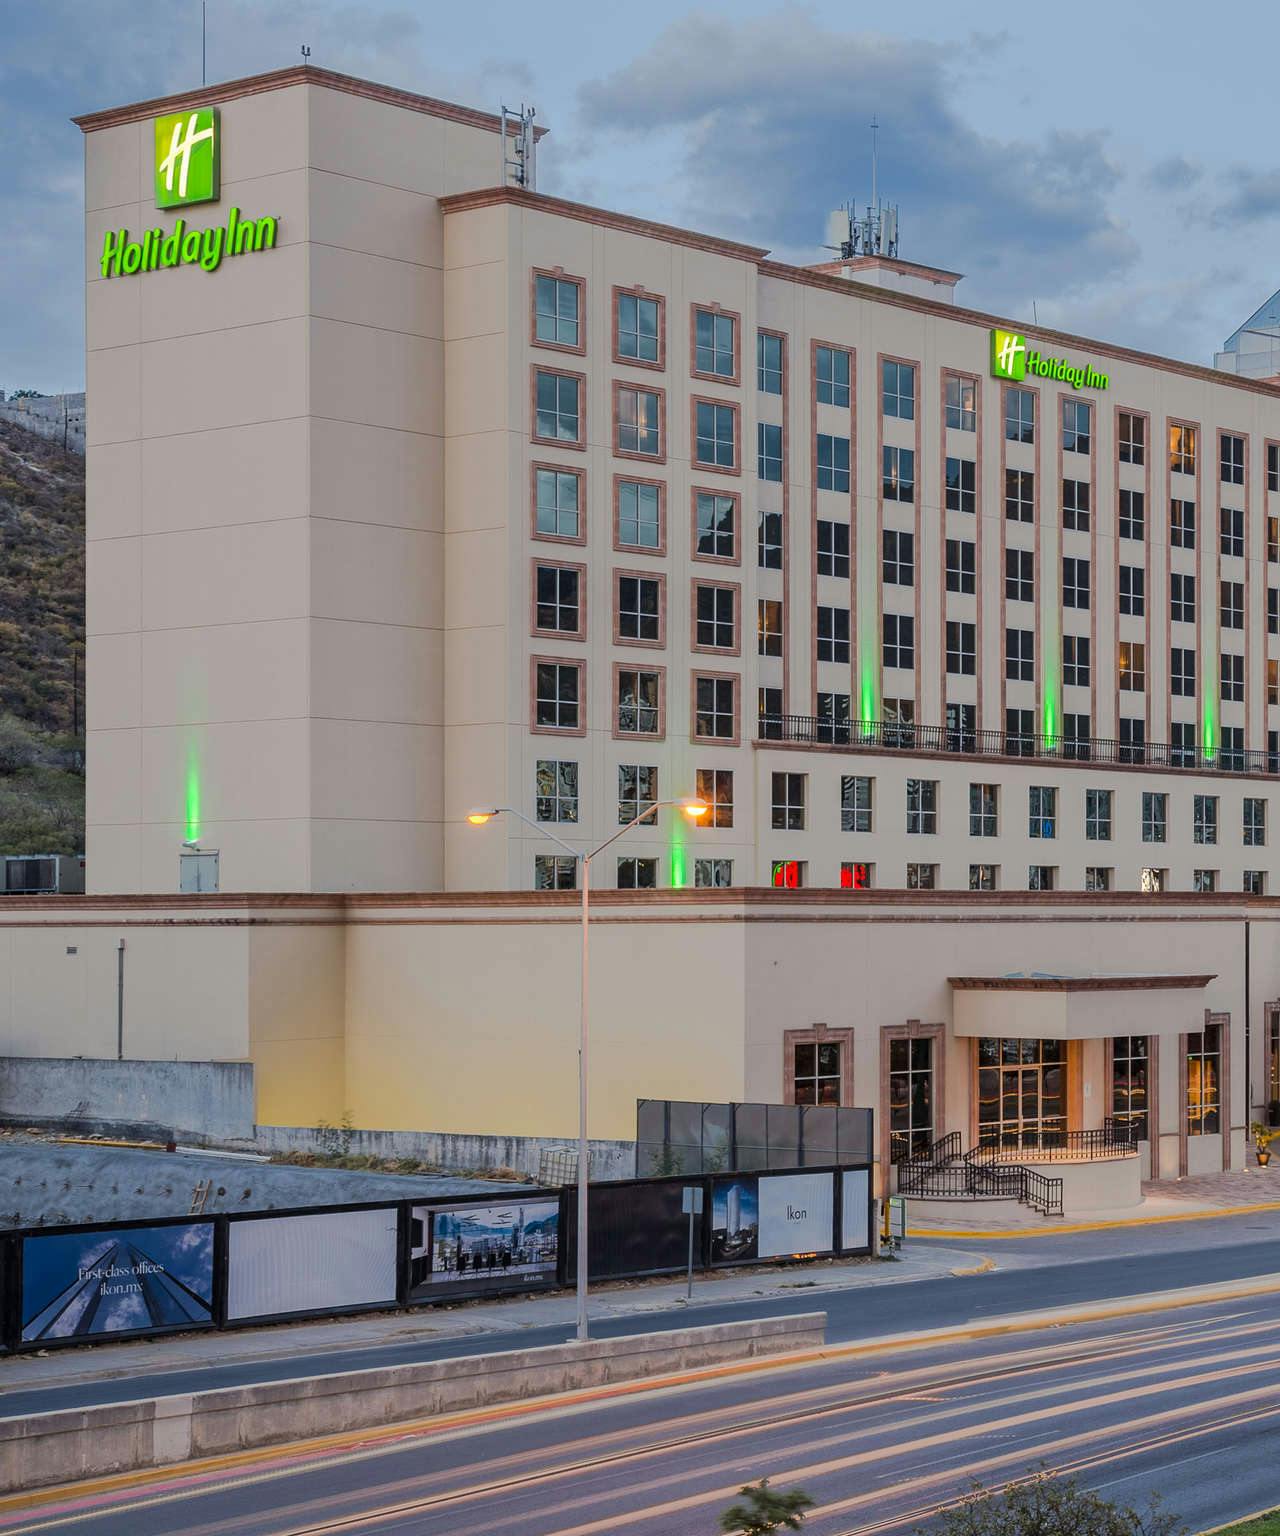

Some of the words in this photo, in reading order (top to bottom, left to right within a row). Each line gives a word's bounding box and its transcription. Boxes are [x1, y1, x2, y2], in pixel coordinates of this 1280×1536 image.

[100, 218, 226, 278] Holiday
[226, 207, 278, 256] Inn
[1027, 350, 1085, 390] Holiday
[1086, 363, 1109, 390] Inn
[786, 1204, 807, 1221] Ikon
[78, 1264, 130, 1281] First-class
[131, 1260, 165, 1276] offices
[100, 1282, 144, 1296] ikon.mx
